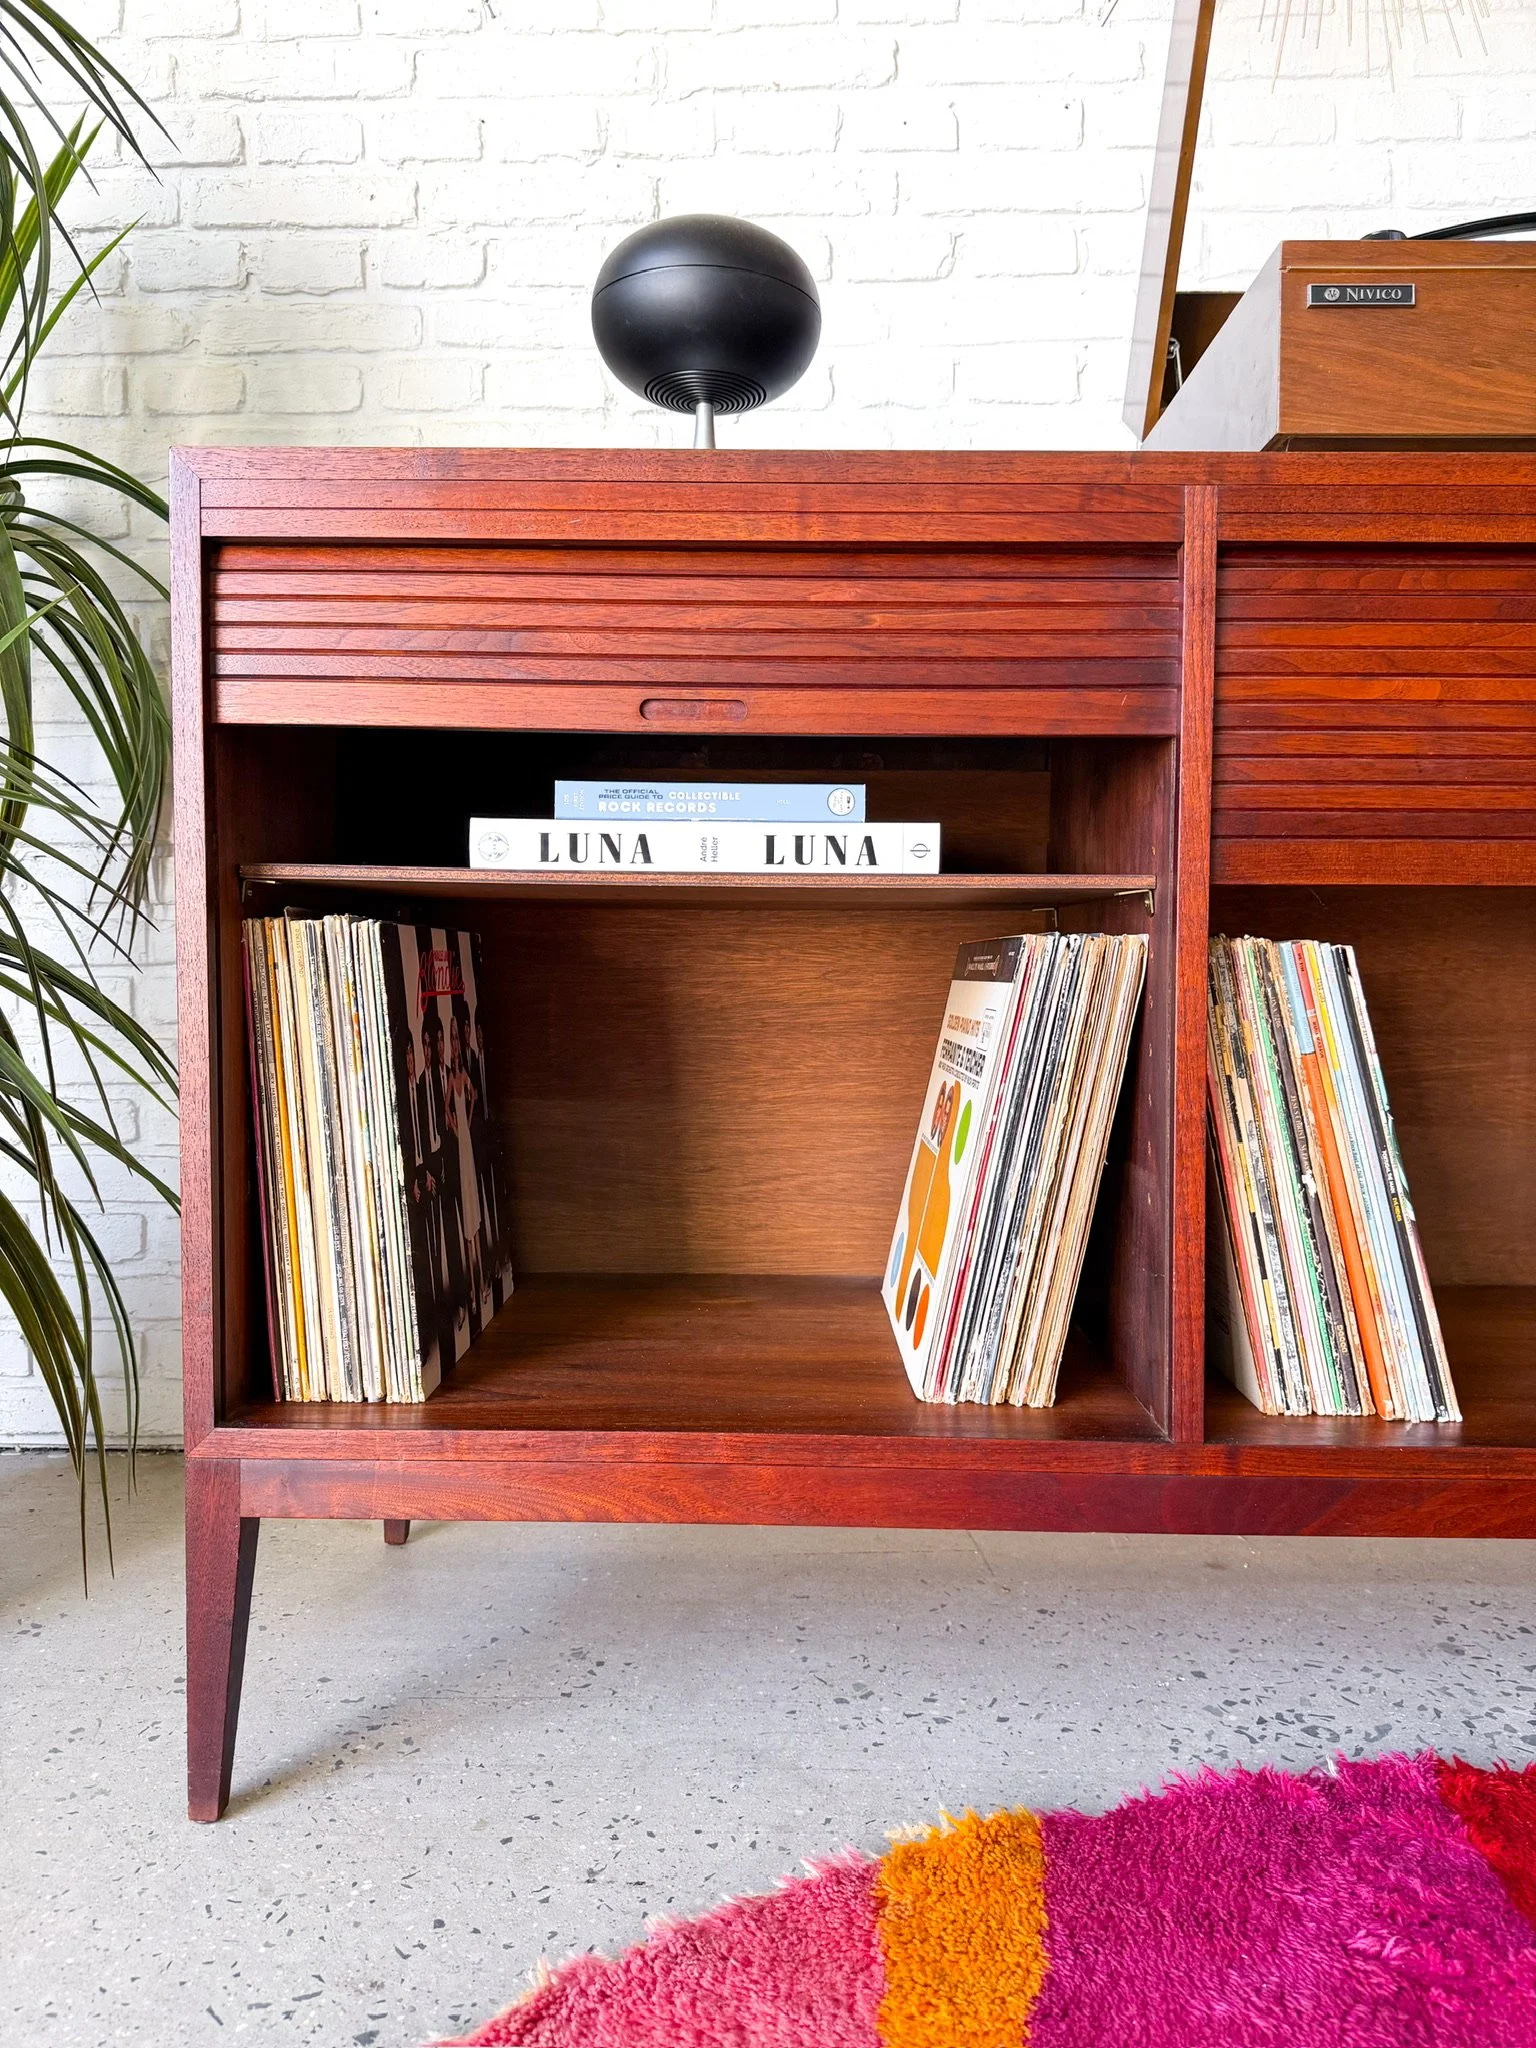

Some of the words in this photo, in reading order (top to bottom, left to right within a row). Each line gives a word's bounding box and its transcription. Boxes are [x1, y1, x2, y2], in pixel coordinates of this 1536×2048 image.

[668, 791, 741, 801] COLLECTIBLE
[598, 801, 641, 813] ROCK
[646, 802, 717, 814] RECORDS
[537, 832, 655, 864] LUNA
[764, 834, 880, 866] LUNA
